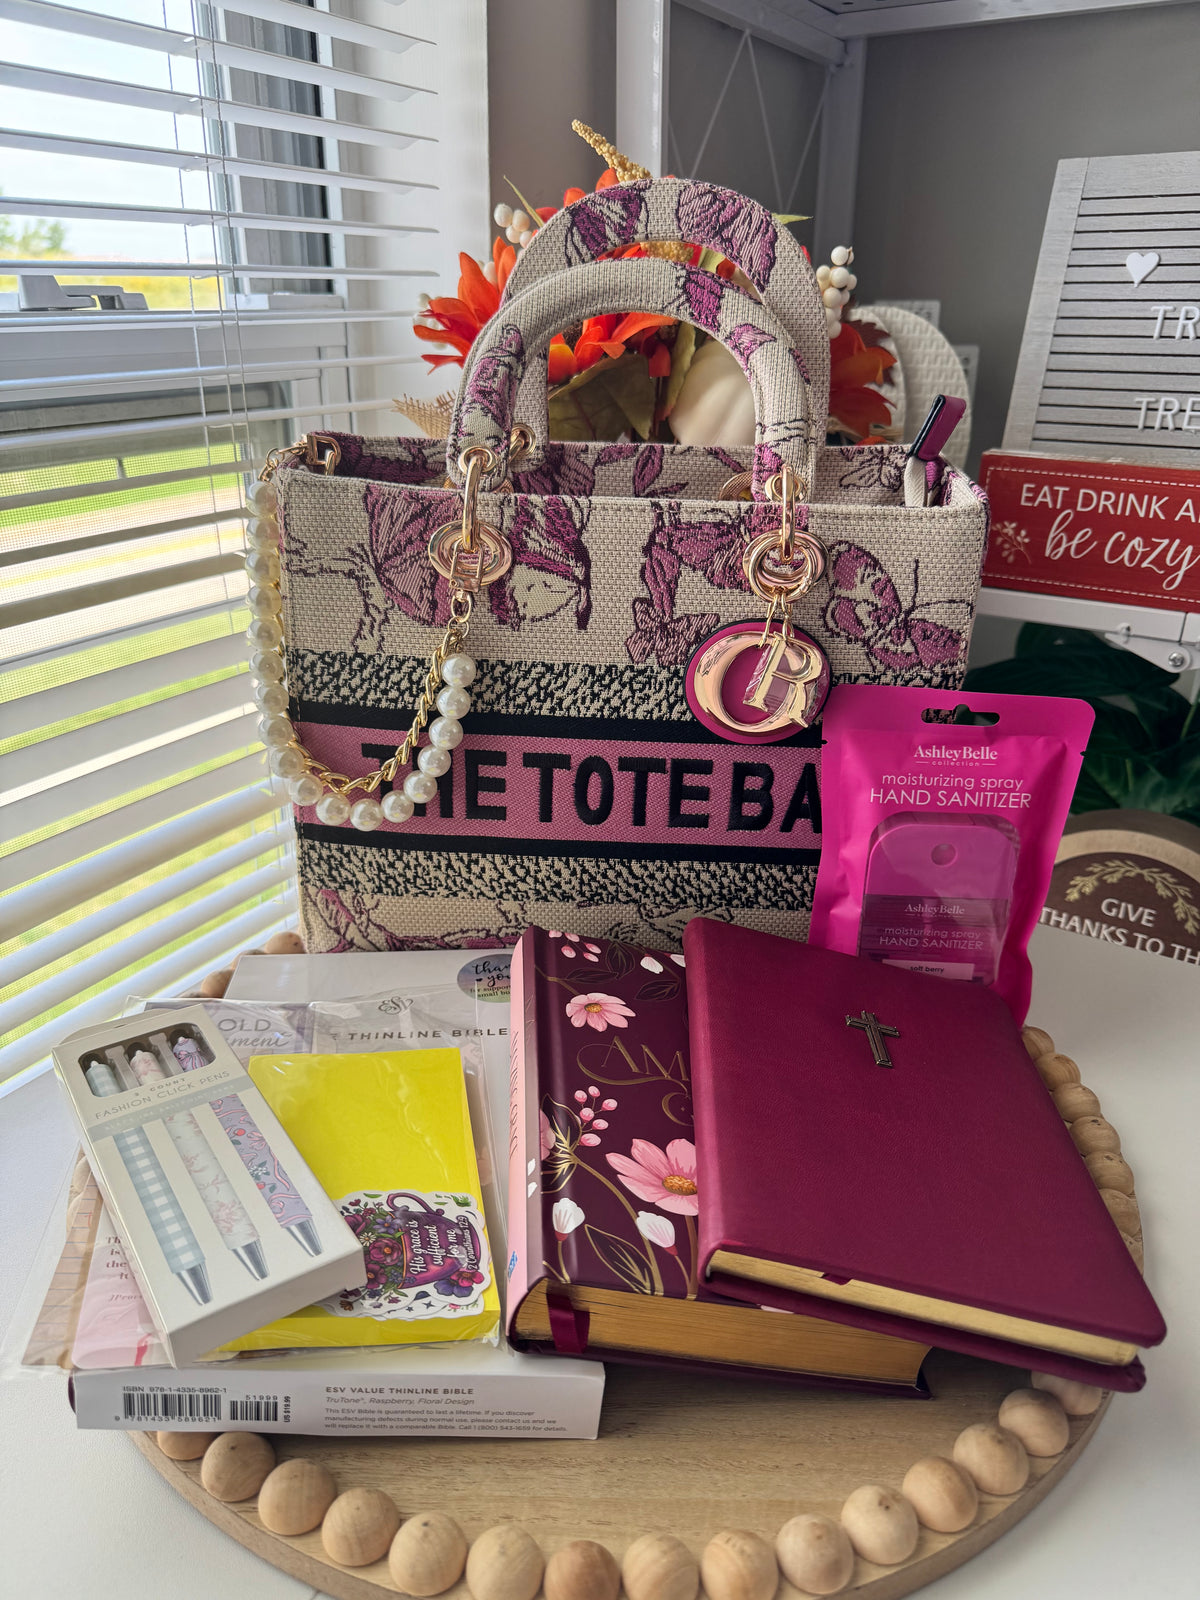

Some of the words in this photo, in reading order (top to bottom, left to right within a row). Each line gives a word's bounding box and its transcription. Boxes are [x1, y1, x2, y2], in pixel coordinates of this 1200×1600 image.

[1020, 483, 1069, 509] EAT
[1076, 489, 1169, 520] DRINK
[1174, 498, 1200, 523] A
[1045, 509, 1098, 560] be
[1104, 531, 1200, 591] cozy
[882, 773, 975, 790] moisturizing
[980, 777, 1024, 791] spray
[523, 752, 714, 829] TOTE
[726, 761, 823, 834] BA
[870, 788, 931, 806] HAND
[936, 790, 1032, 808] SANITIZER
[1101, 898, 1157, 928] GIVE
[884, 926, 948, 939] moisturizing
[951, 930, 981, 940] spray
[1038, 907, 1129, 946] THANKS
[1133, 932, 1165, 955] TO
[880, 936, 919, 947] HAND
[922, 938, 984, 950] SANITIZER
[925, 966, 945, 974] berry
[217, 1018, 271, 1032] OLD
[348, 1030, 442, 1041] THINLINE
[452, 1028, 508, 1038] BIBLE
[95, 1096, 152, 1120] FASHION
[157, 1082, 196, 1099] CLICK
[200, 1071, 231, 1085] PENS
[406, 1219, 418, 1228] is
[410, 1229, 428, 1255] grace
[446, 1228, 457, 1242] me
[424, 1224, 446, 1265] sufficient
[446, 1243, 465, 1257] for
[409, 1255, 427, 1274] His
[388, 1387, 439, 1395] THINLINE
[417, 1397, 442, 1405] Floral
[444, 1398, 475, 1406] Design
[283, 1414, 291, 1423] US
